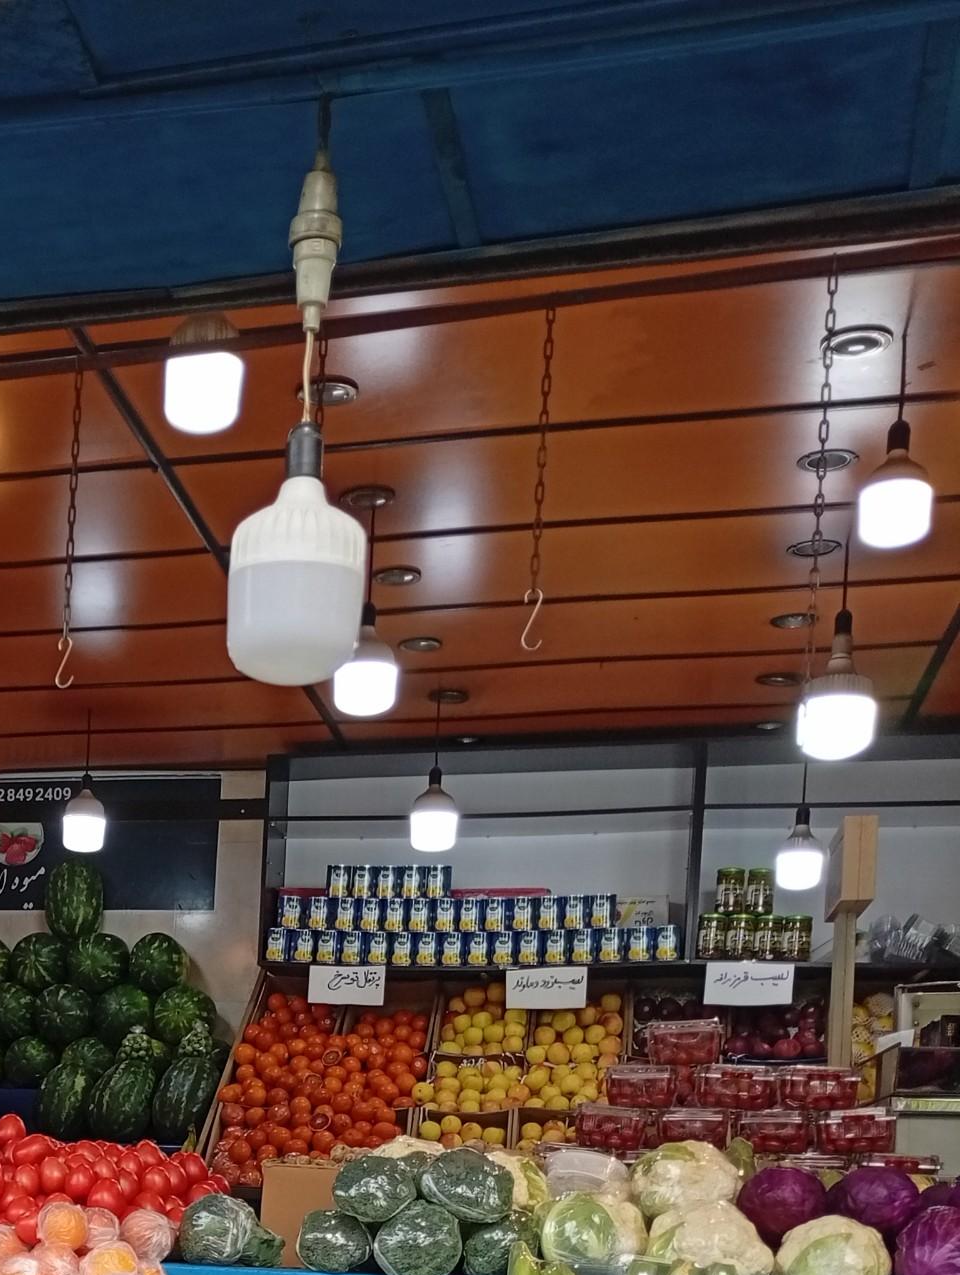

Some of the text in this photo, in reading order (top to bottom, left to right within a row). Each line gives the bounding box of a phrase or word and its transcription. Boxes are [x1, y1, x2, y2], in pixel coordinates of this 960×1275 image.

[356, 970, 381, 988] پرتقال
[553, 975, 584, 990] سیب
[750, 969, 789, 986] سیب
